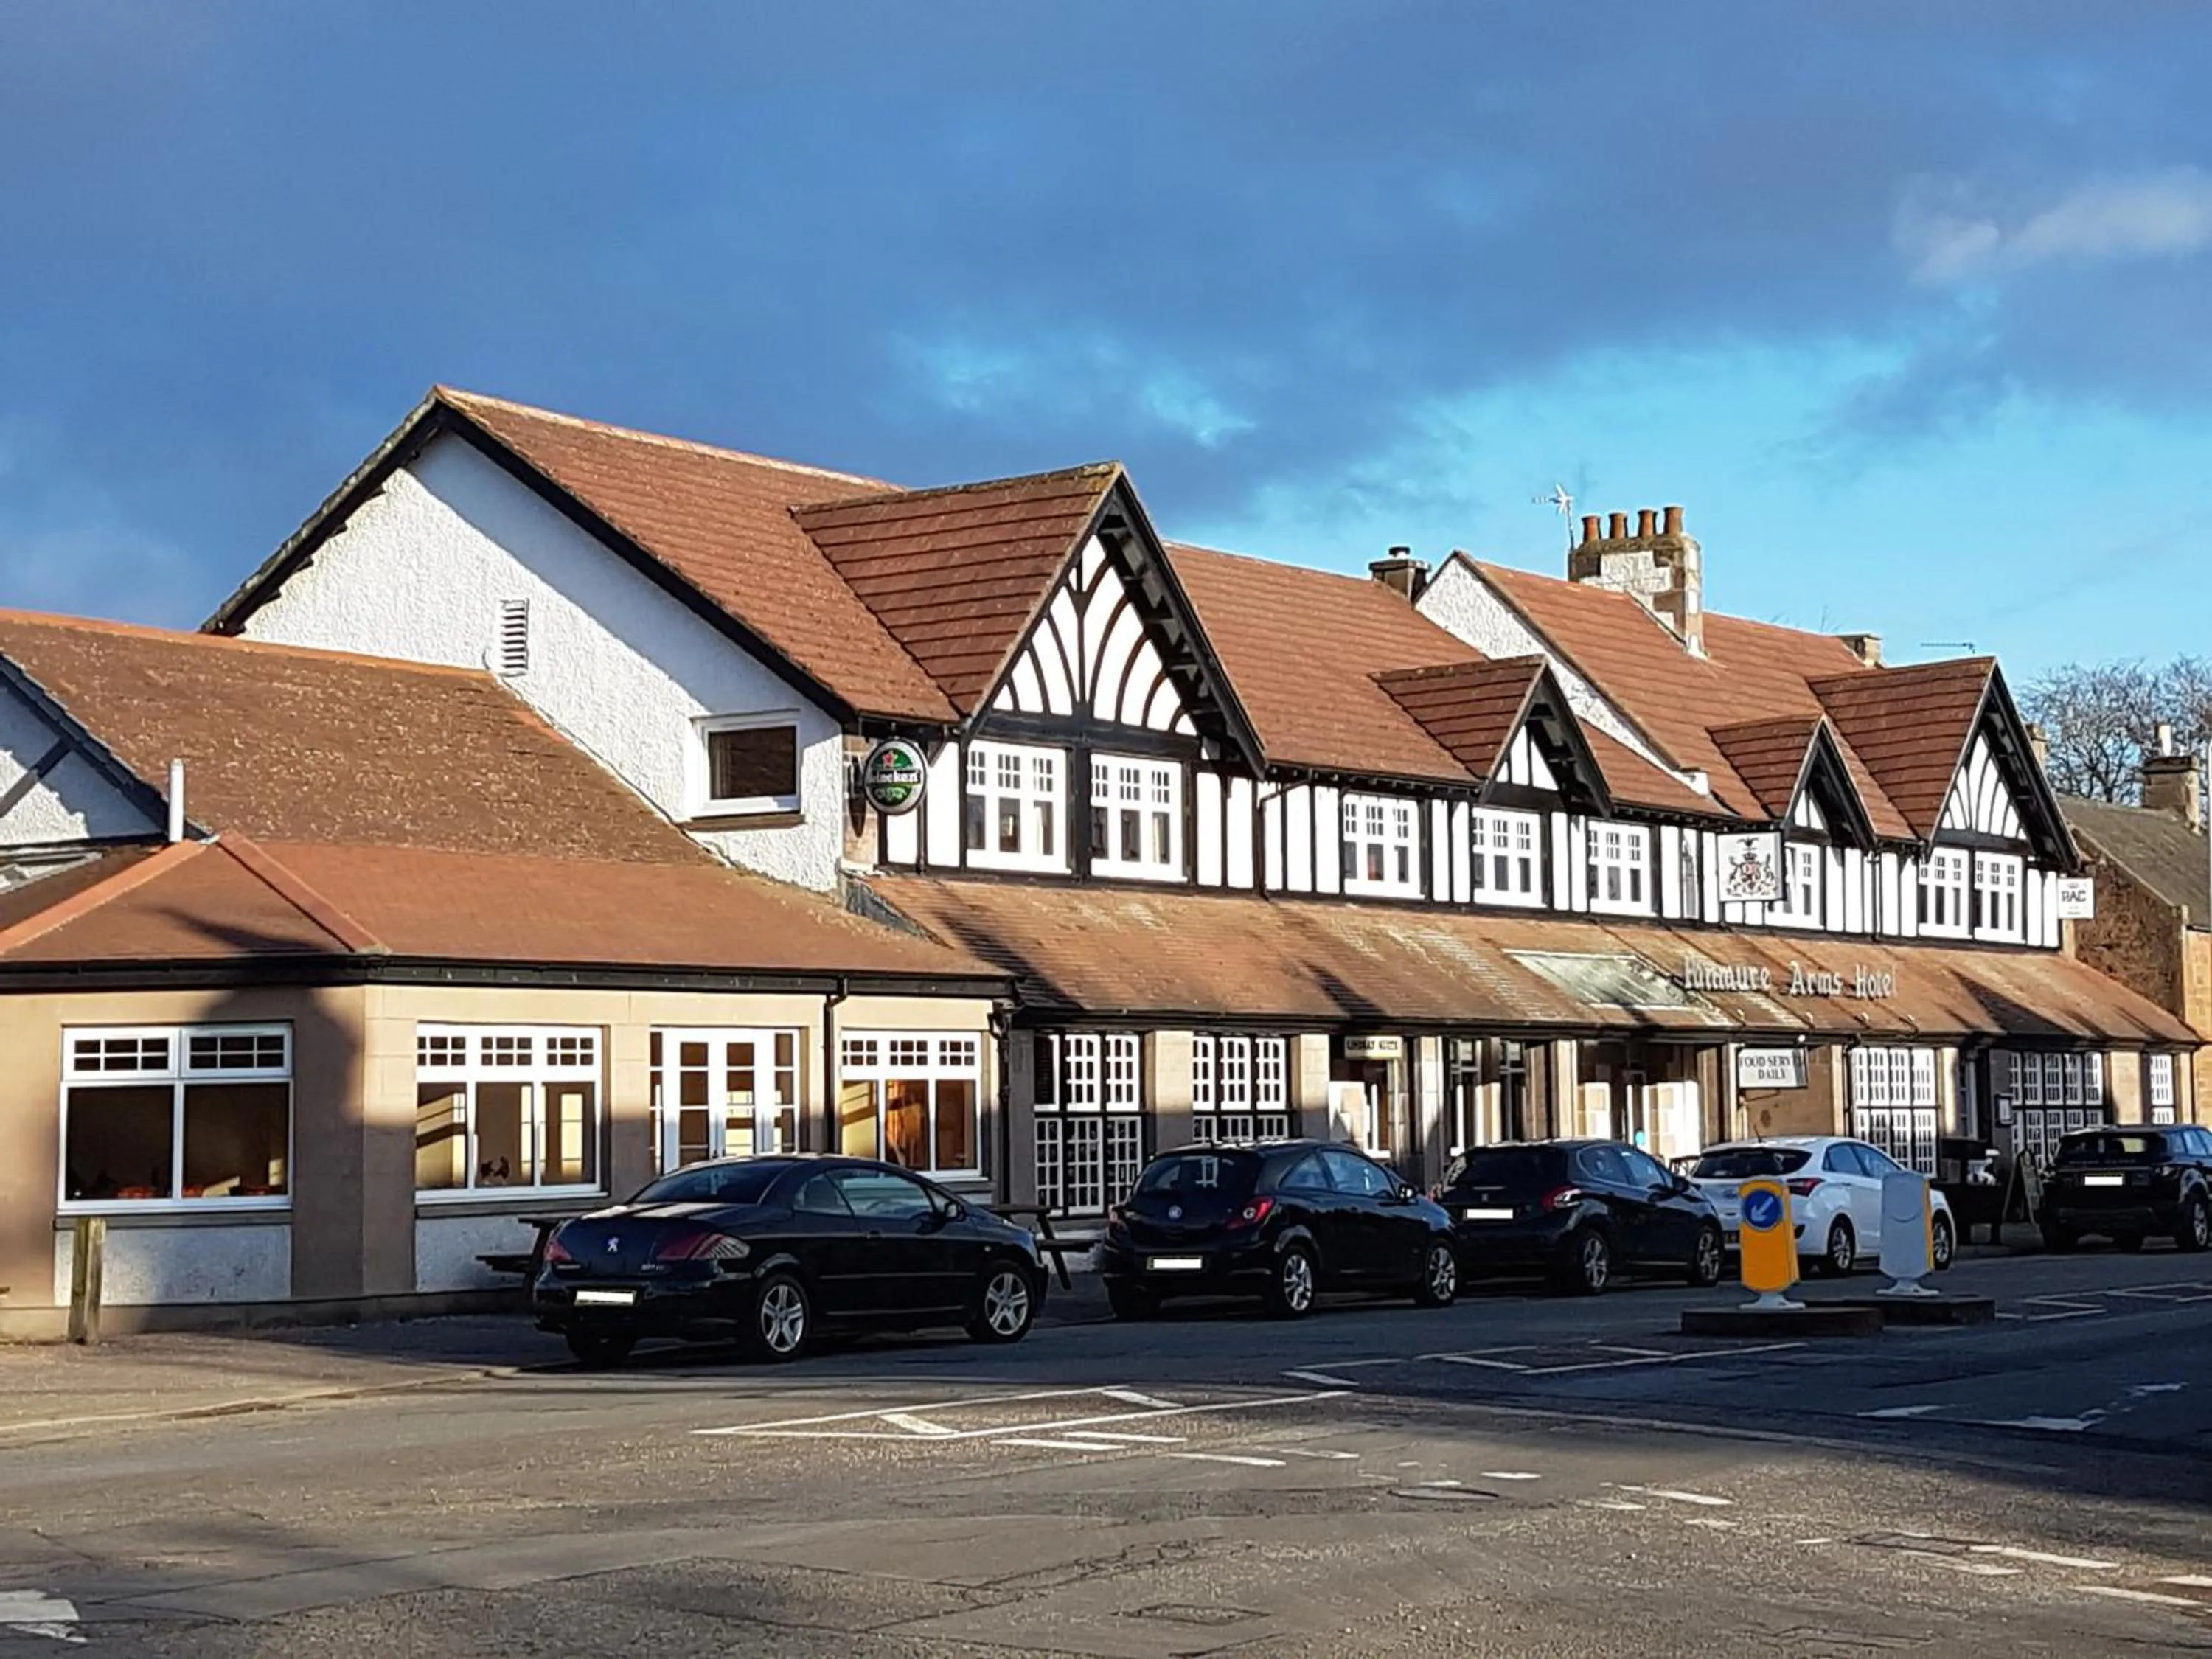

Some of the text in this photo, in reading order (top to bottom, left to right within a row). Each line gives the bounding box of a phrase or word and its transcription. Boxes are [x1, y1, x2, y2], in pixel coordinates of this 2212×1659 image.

[2061, 889, 2087, 902] RAC
[1790, 961, 1843, 995] Arms
[1855, 963, 1898, 998] Hotel
[1758, 1067, 1786, 1080] DAILY
